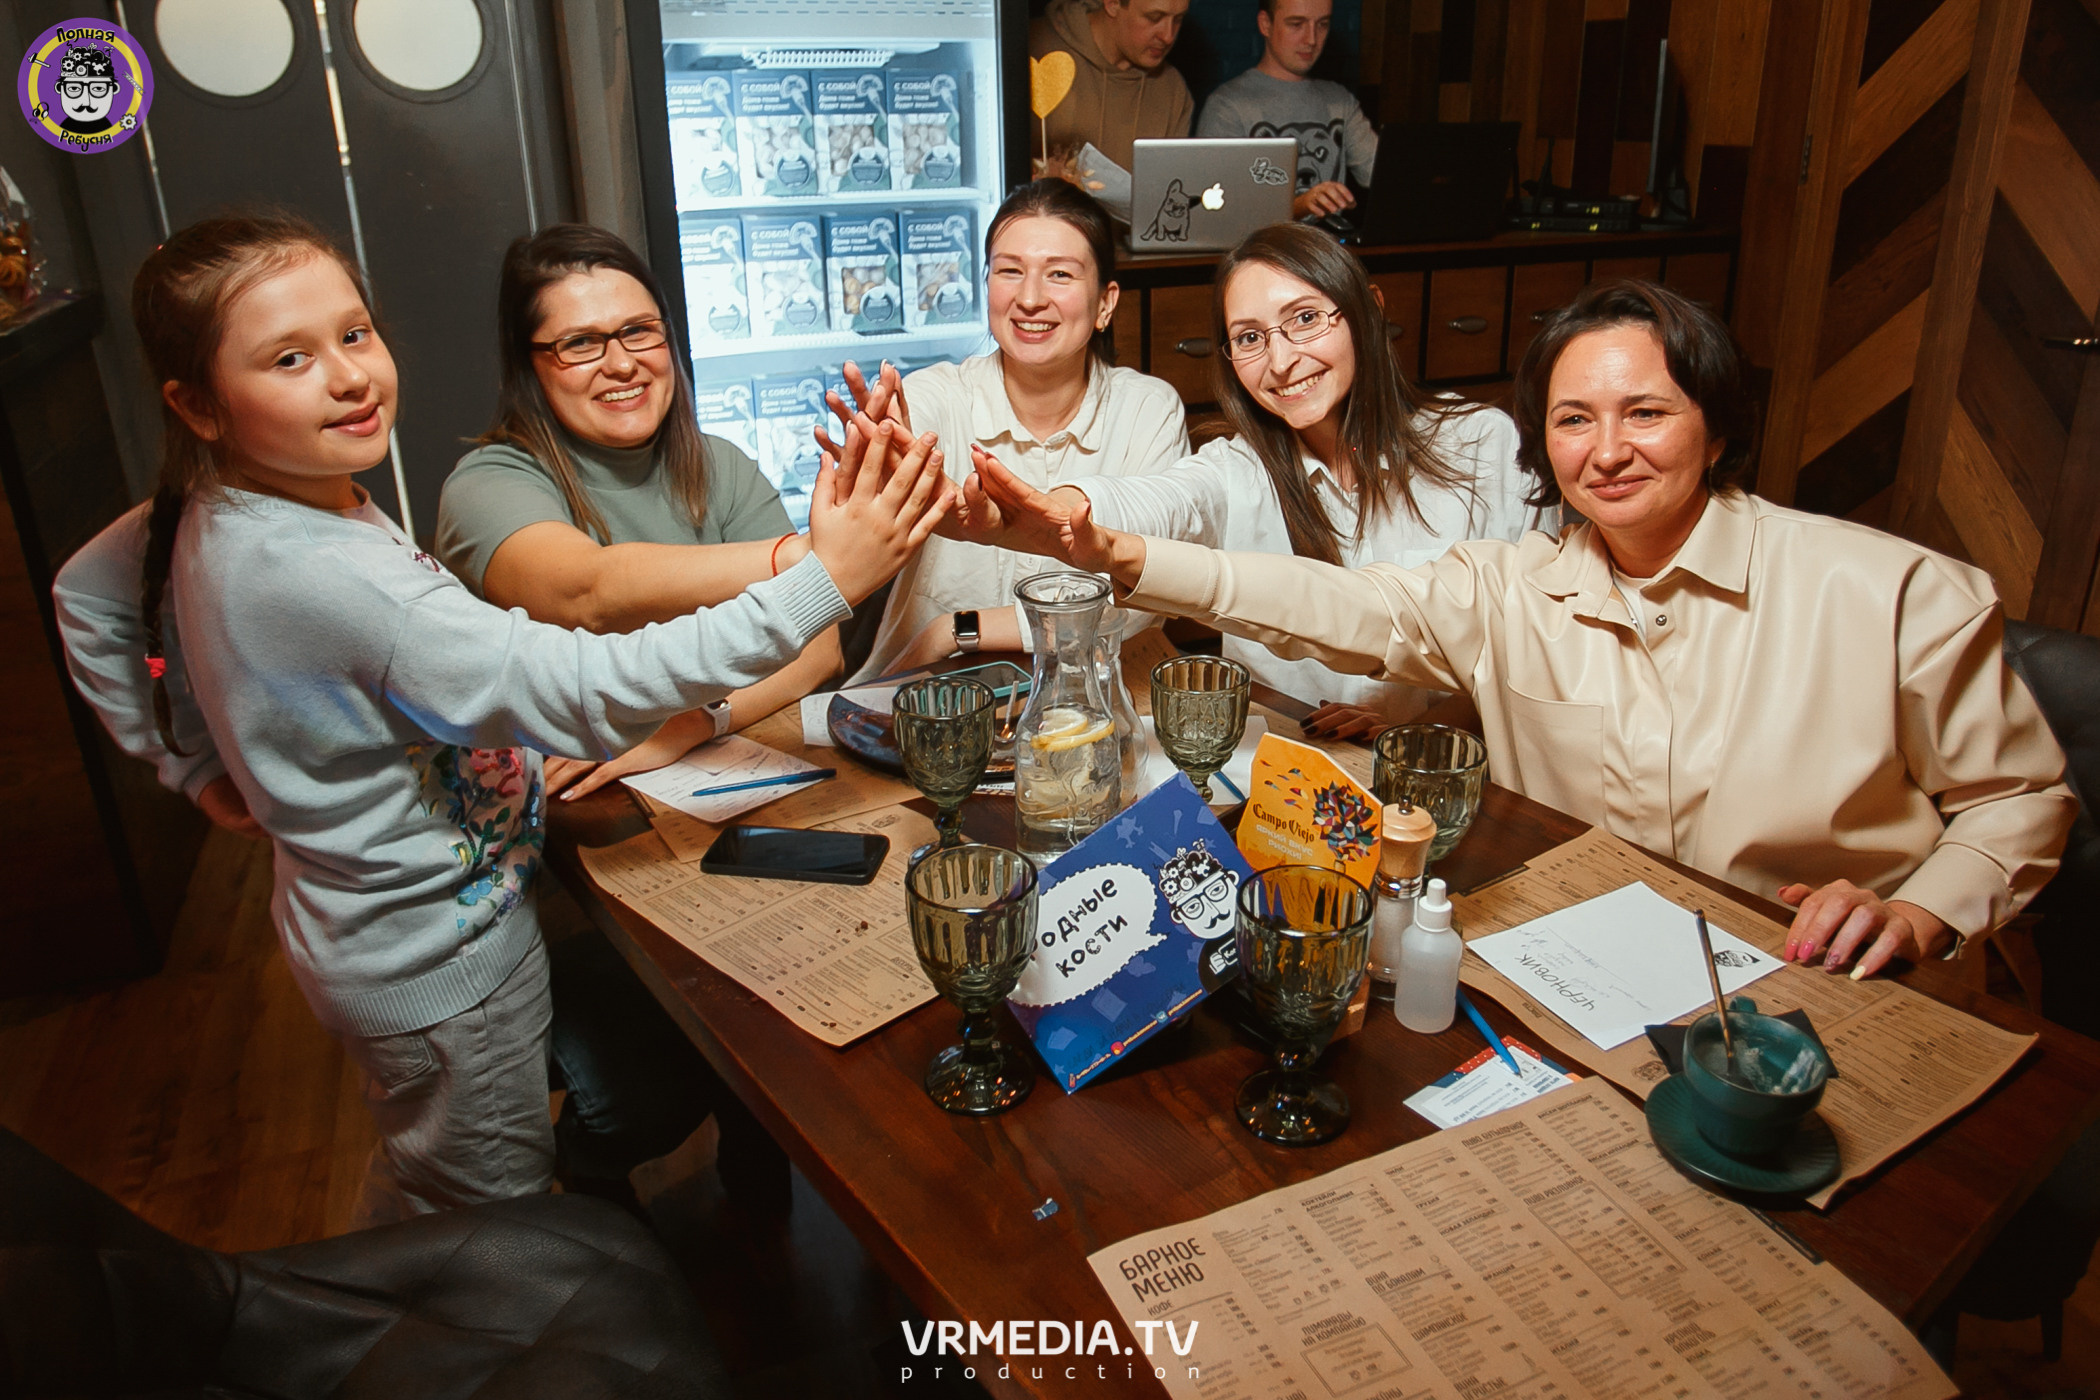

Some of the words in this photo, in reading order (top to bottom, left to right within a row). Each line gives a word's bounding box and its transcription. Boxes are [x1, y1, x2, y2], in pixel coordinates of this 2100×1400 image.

[1253, 803, 1287, 830] Campo
[1288, 819, 1314, 844] Viejo
[1033, 876, 1119, 950] одные
[1056, 912, 1129, 978] кости
[1513, 952, 1596, 1012] ЧЕРНОВИК
[1119, 1237, 1206, 1281] БАРНОЕ
[1131, 1261, 1205, 1303] МЕНЮ
[1365, 1270, 1389, 1286] ВИНА
[1385, 1267, 1426, 1292] БОКАЛАМ
[1147, 1300, 1174, 1317] КОФЕ
[1301, 1310, 1354, 1336] ЛИМОНАДЫ
[1301, 1336, 1316, 1347] НА
[1316, 1316, 1367, 1343] КОМПАНИЮ
[1411, 1312, 1469, 1342] ШАМПАНСКОЕ
